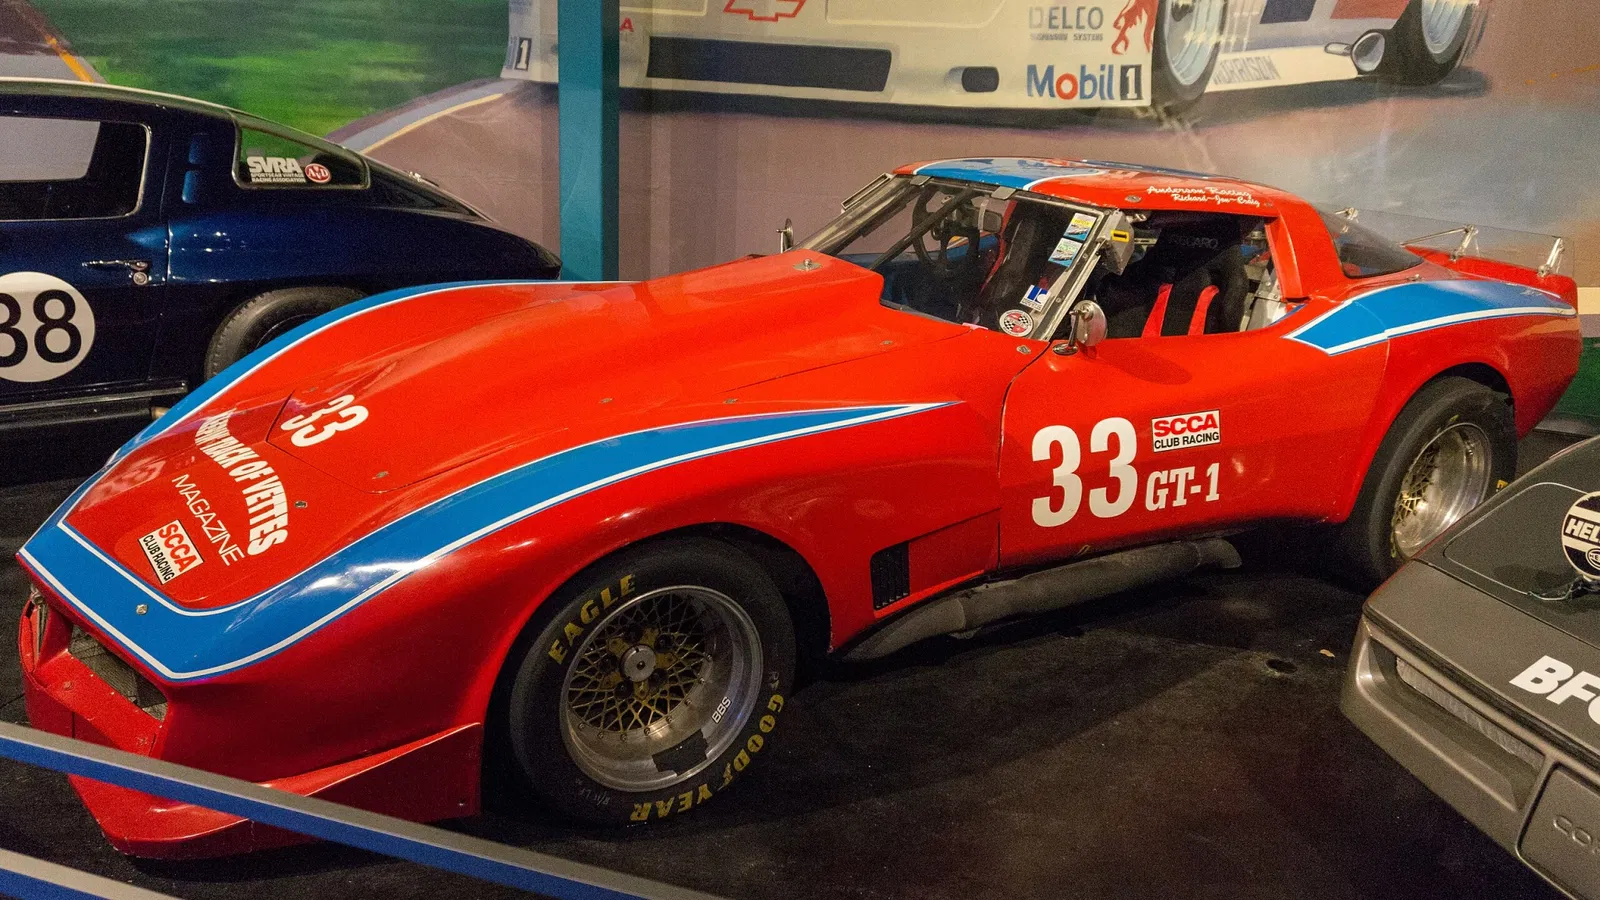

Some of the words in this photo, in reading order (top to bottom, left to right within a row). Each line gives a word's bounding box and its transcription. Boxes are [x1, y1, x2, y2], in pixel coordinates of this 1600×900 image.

[1028, 6, 1104, 30] DELCO
[1026, 64, 1115, 100] Mobil
[1124, 66, 1139, 99] 1
[247, 156, 303, 174] SVRA
[1147, 185, 1205, 195] Anderson
[1205, 186, 1251, 200] Racing
[280, 394, 369, 447] 33
[1153, 413, 1219, 438] SCCA
[200, 435, 260, 469] TRACK
[1154, 436, 1180, 450] CLUB
[1182, 431, 1220, 445] RACING
[229, 460, 275, 483] OF
[1031, 416, 1138, 528] 33
[1145, 462, 1220, 512] GT-1
[171, 473, 245, 566] MAGAZINE
[242, 475, 288, 556] VETTES
[1565, 517, 1600, 544] HEL
[143, 534, 158, 556] CLUB
[152, 552, 175, 581] RACING
[158, 523, 198, 573] SCCA
[548, 573, 636, 665] EAGLE
[711, 696, 732, 724] BBS
